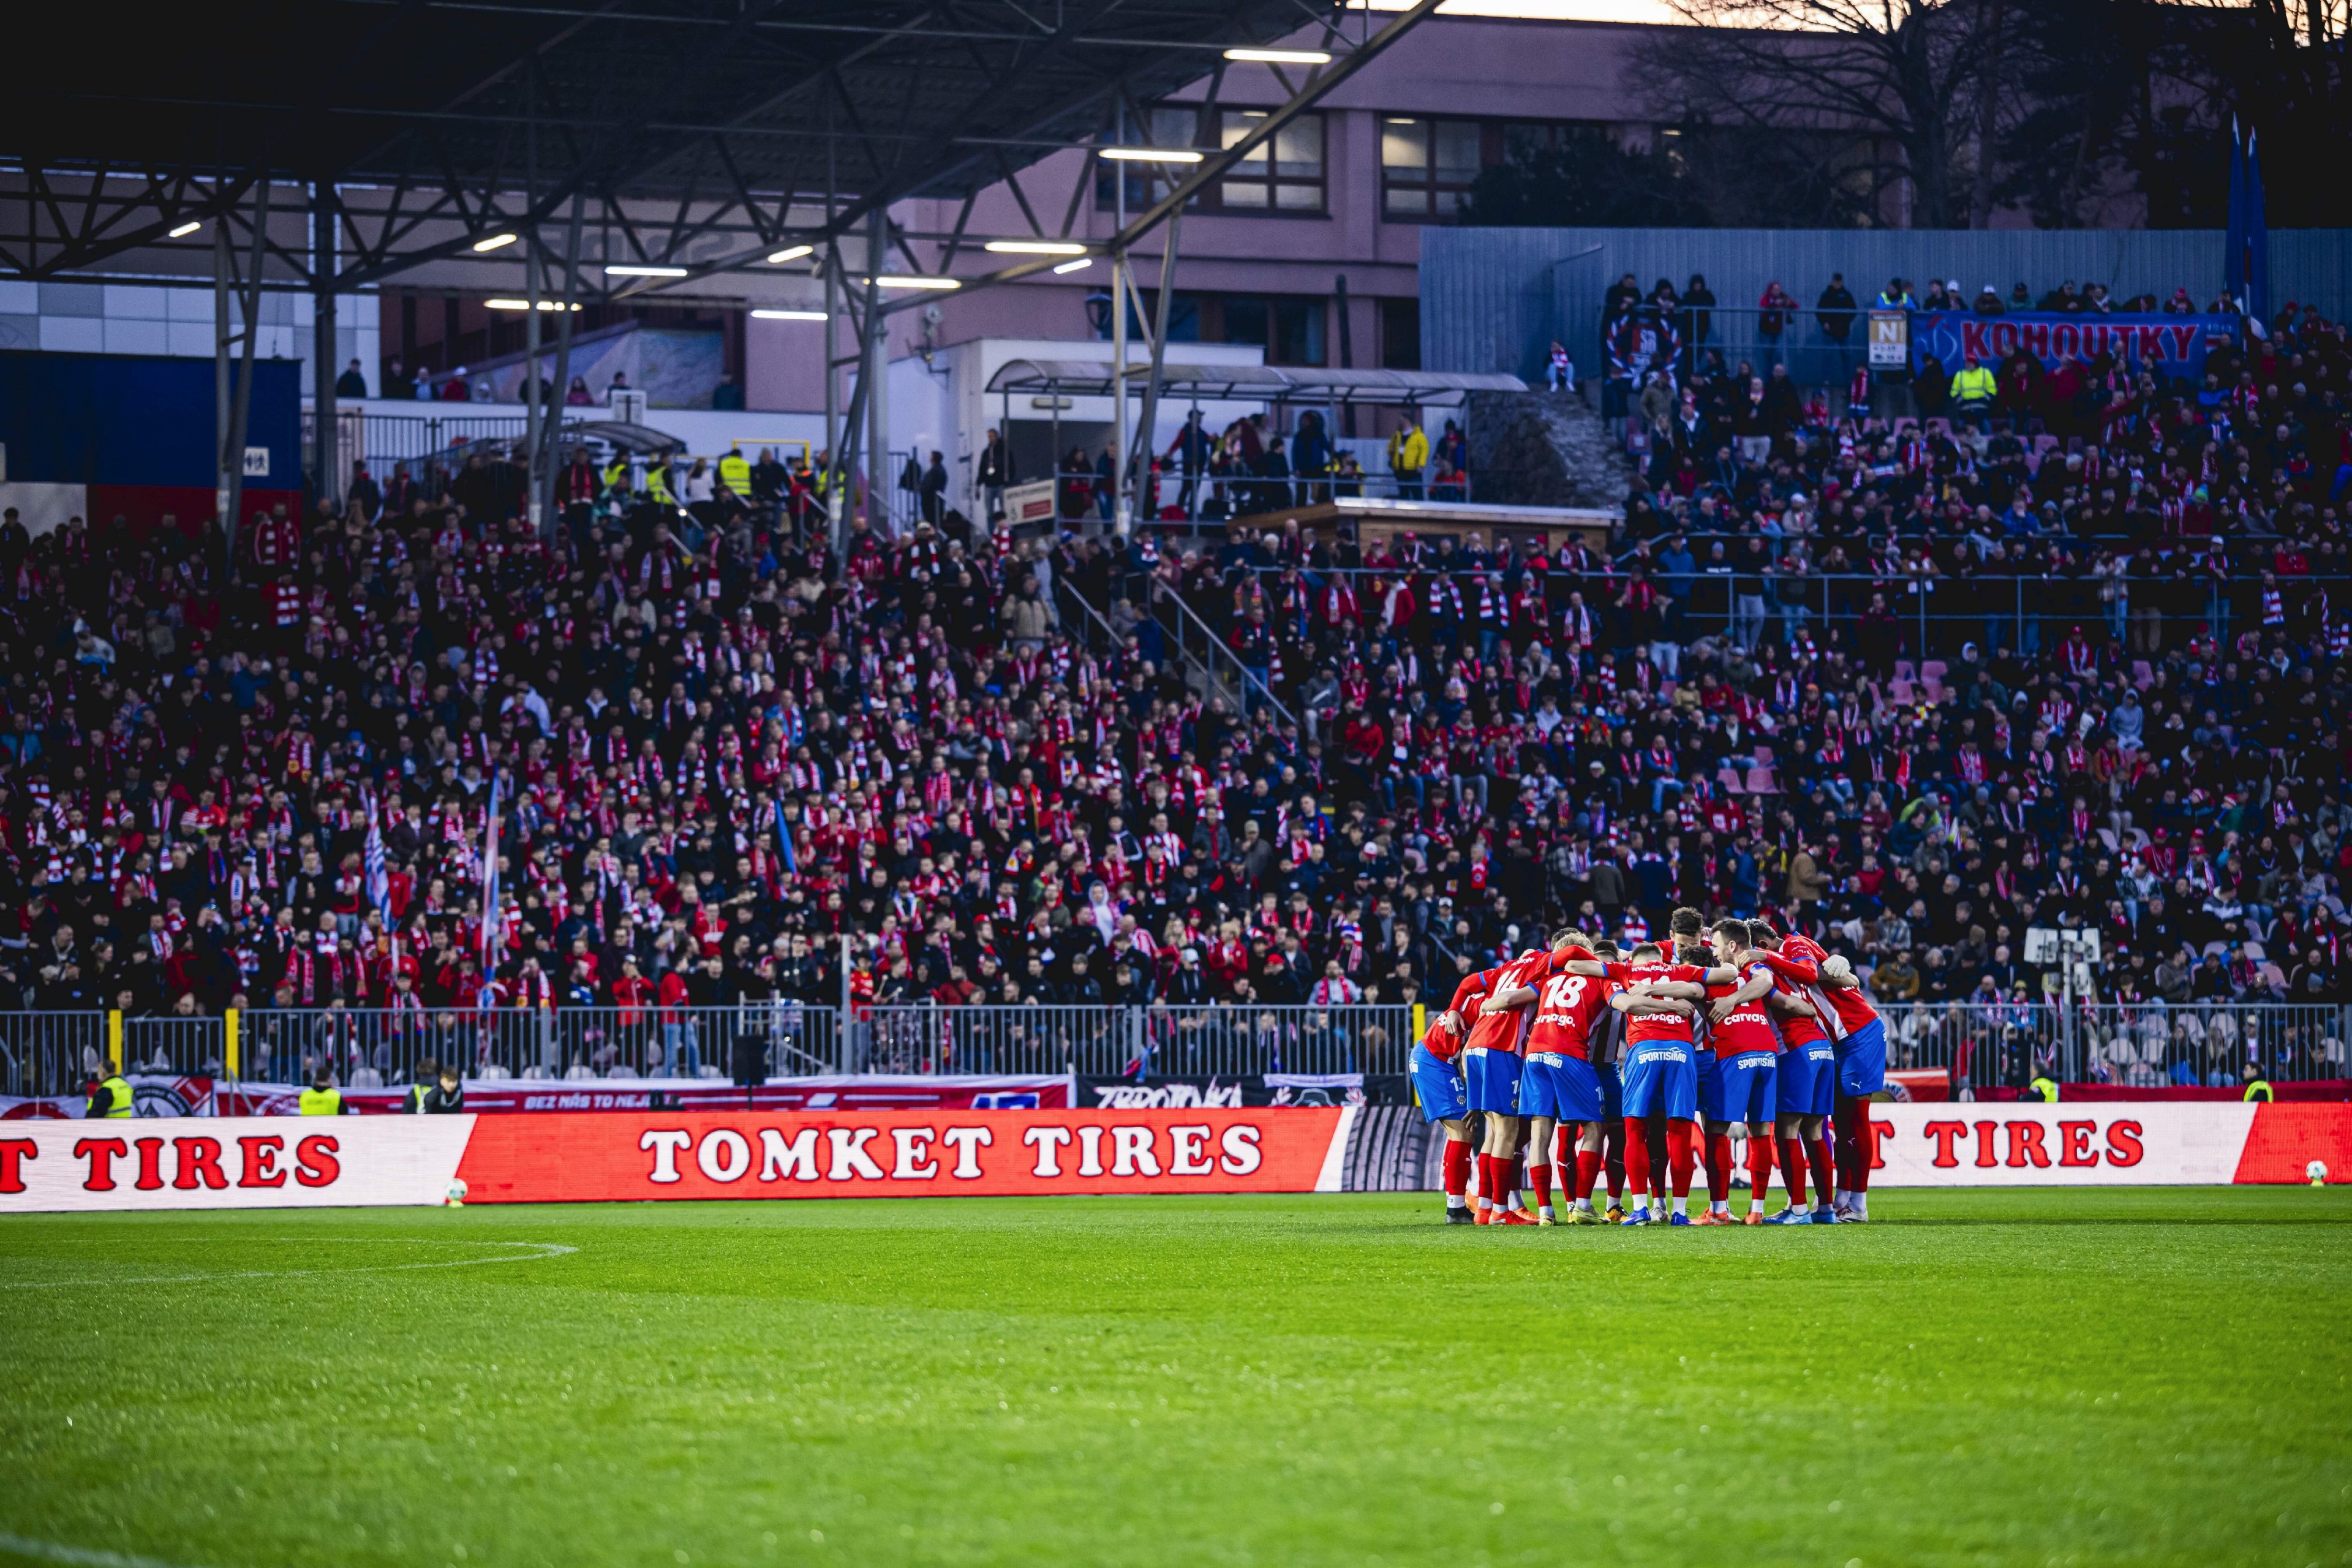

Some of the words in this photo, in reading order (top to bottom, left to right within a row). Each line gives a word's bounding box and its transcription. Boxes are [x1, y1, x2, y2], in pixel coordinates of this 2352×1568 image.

[1878, 321, 1898, 342] N
[1960, 321, 2199, 362] KOHOUTKY
[1544, 974, 1588, 1009] 18
[1724, 1012, 1770, 1026] carvag
[1638, 1051, 1687, 1065] SPORTISIMO
[594, 1094, 614, 1108] TO
[639, 1126, 993, 1184] TOMKET
[1023, 1123, 1263, 1178] TIRES
[1923, 1118, 2145, 1169] TIRES
[73, 1134, 341, 1191] TIRES
